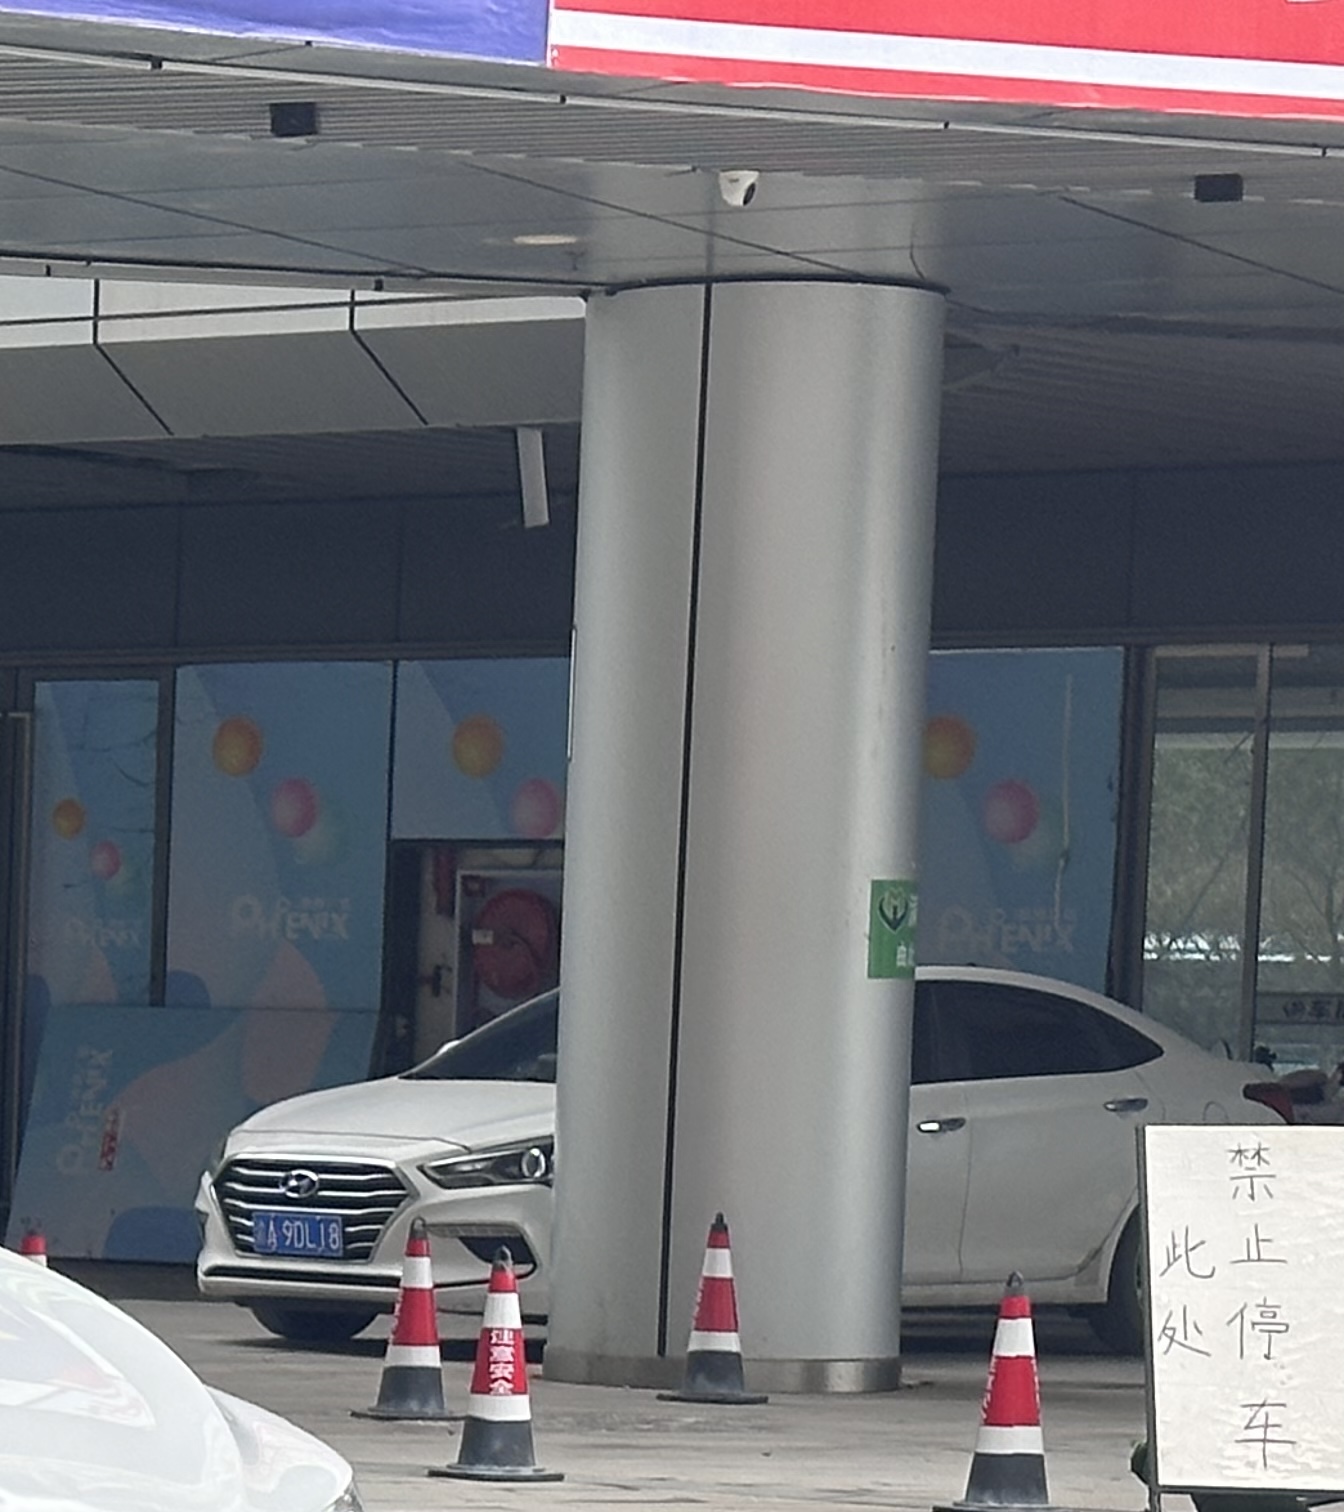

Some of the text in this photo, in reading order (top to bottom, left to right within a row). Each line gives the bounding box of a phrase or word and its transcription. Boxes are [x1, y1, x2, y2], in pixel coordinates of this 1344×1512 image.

[1157, 1224, 1216, 1358] 此处
[1226, 1141, 1297, 1471] 禁止停车
[489, 1328, 515, 1396] 注意安全
